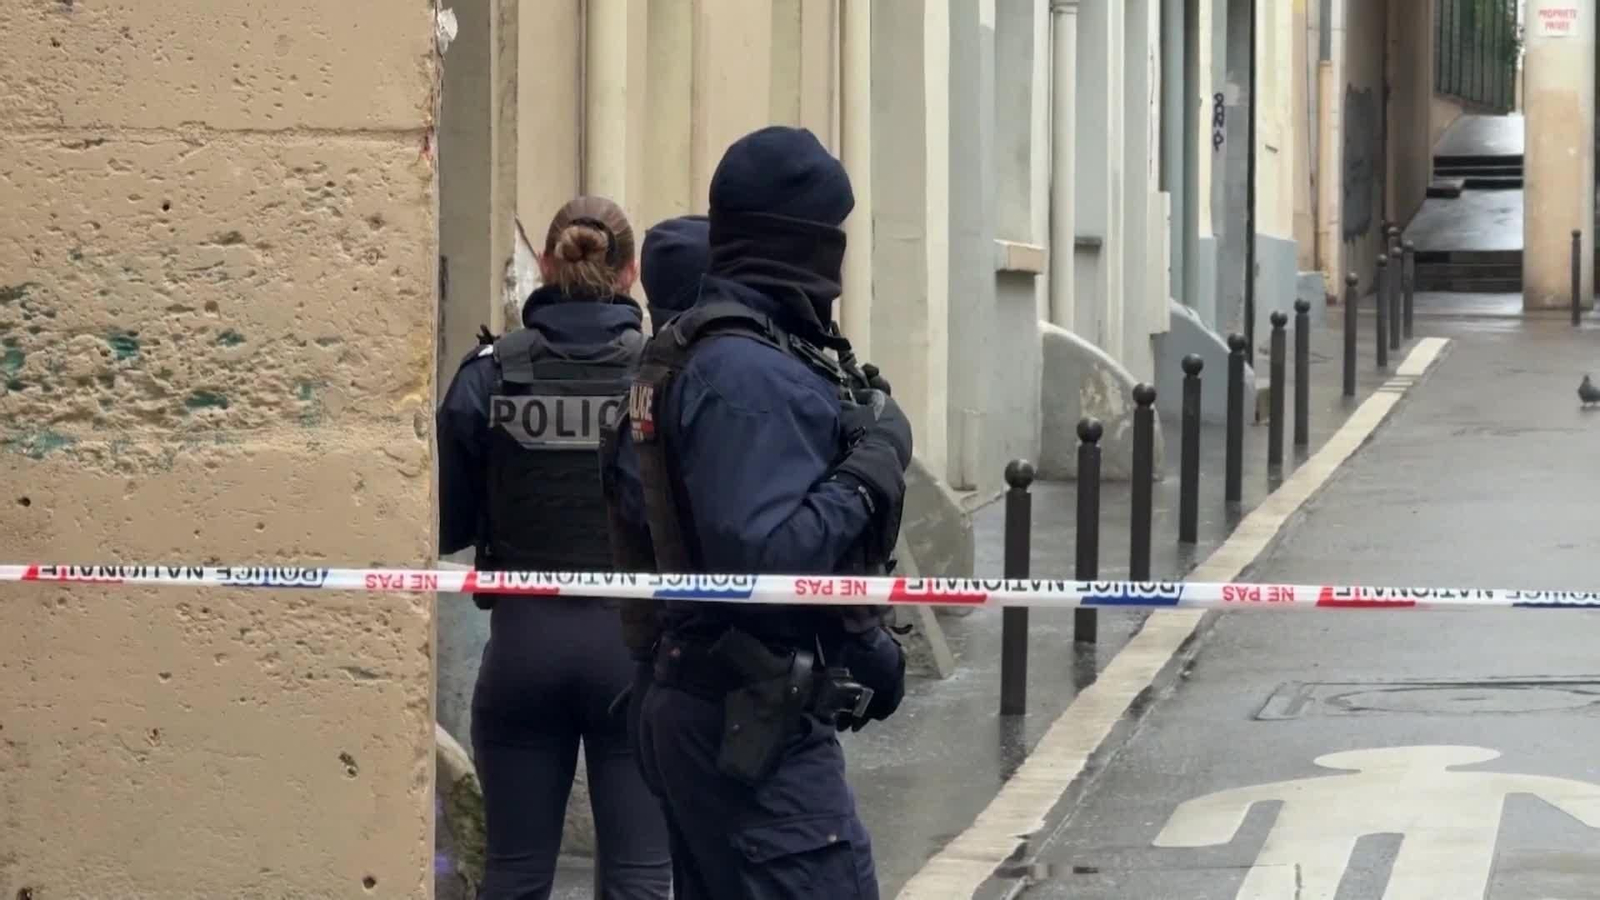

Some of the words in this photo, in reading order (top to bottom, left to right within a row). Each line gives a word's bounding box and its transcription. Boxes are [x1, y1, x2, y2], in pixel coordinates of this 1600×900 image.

[494, 399, 620, 438] POLIC
[366, 574, 404, 589] PAS
[411, 574, 437, 589] NE
[795, 579, 833, 595] PAS
[841, 580, 867, 595] NE
[1222, 585, 1260, 601] PAS
[1268, 586, 1294, 601] NE
